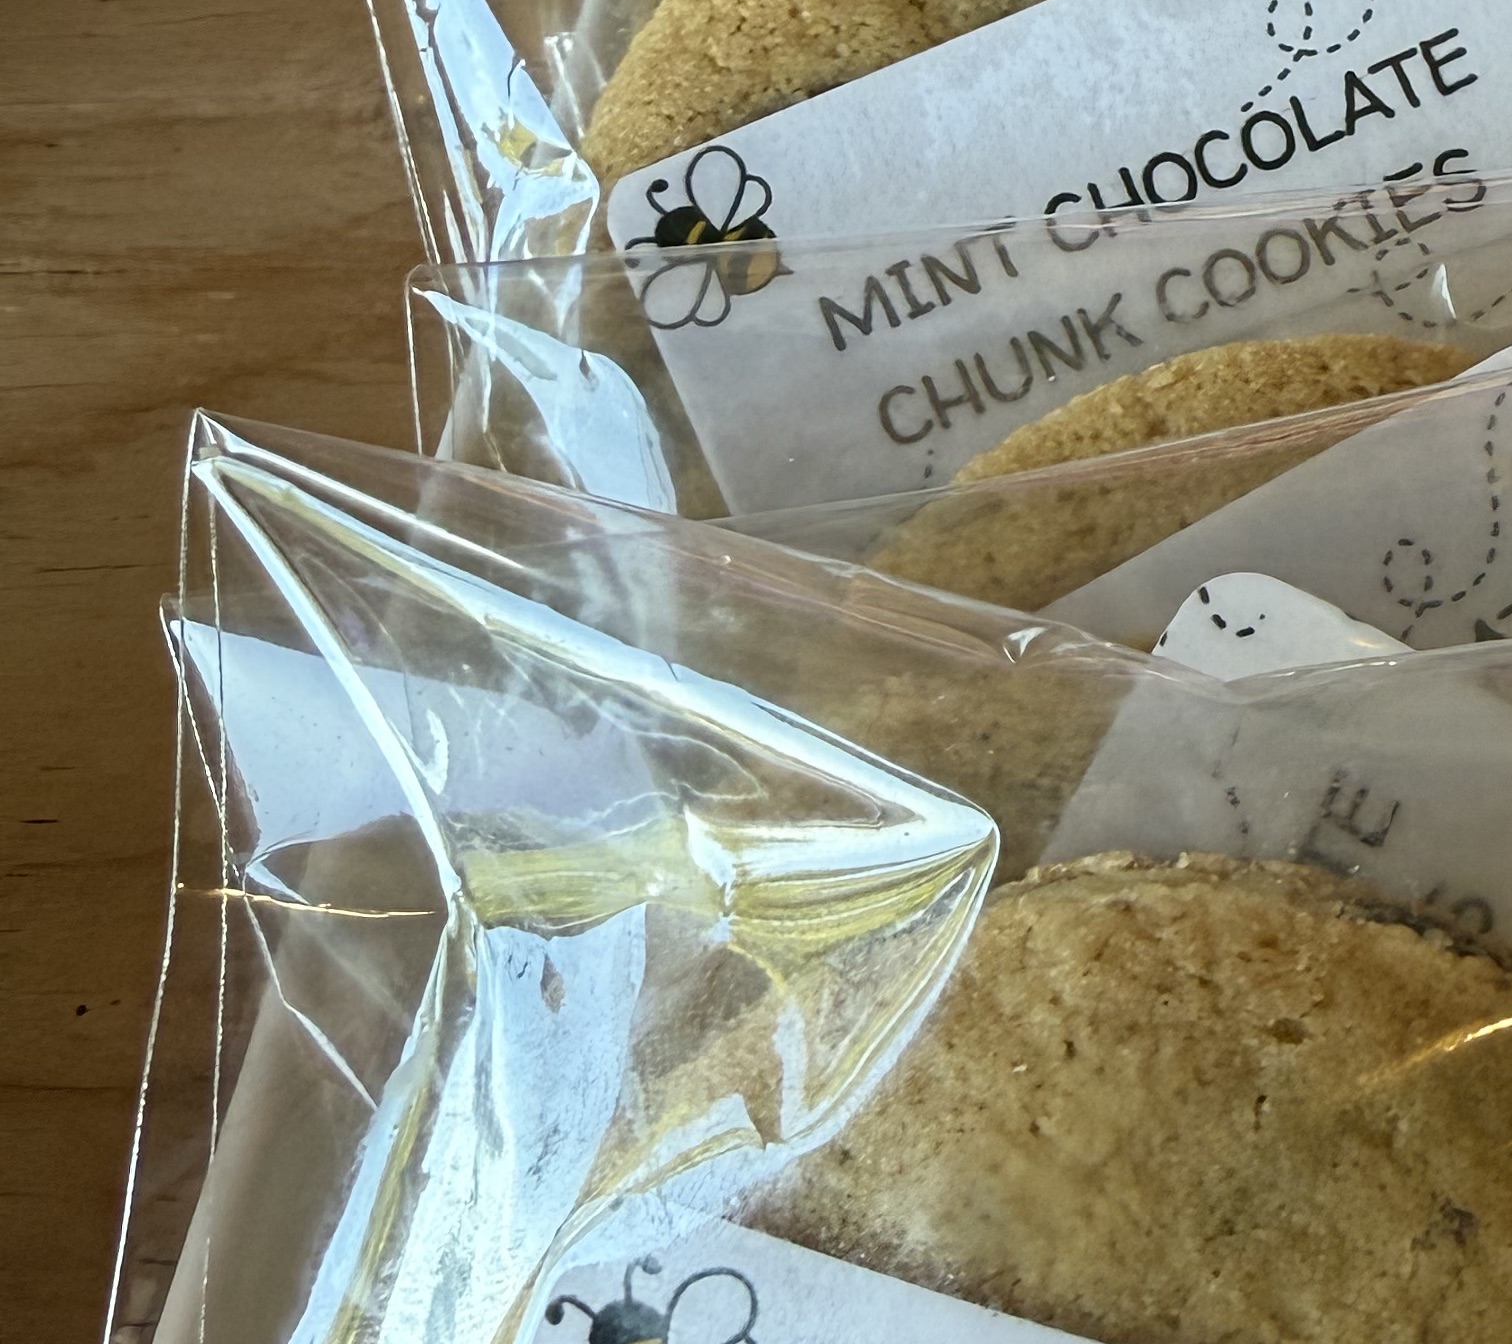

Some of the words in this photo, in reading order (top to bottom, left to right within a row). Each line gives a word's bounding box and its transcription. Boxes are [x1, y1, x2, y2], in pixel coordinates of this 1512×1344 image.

[818, 215, 1018, 353] MINT
[1044, 28, 1478, 253] CHOCOLATE
[878, 292, 1144, 445] CHUNK
[1156, 148, 1488, 324] COOKIES
